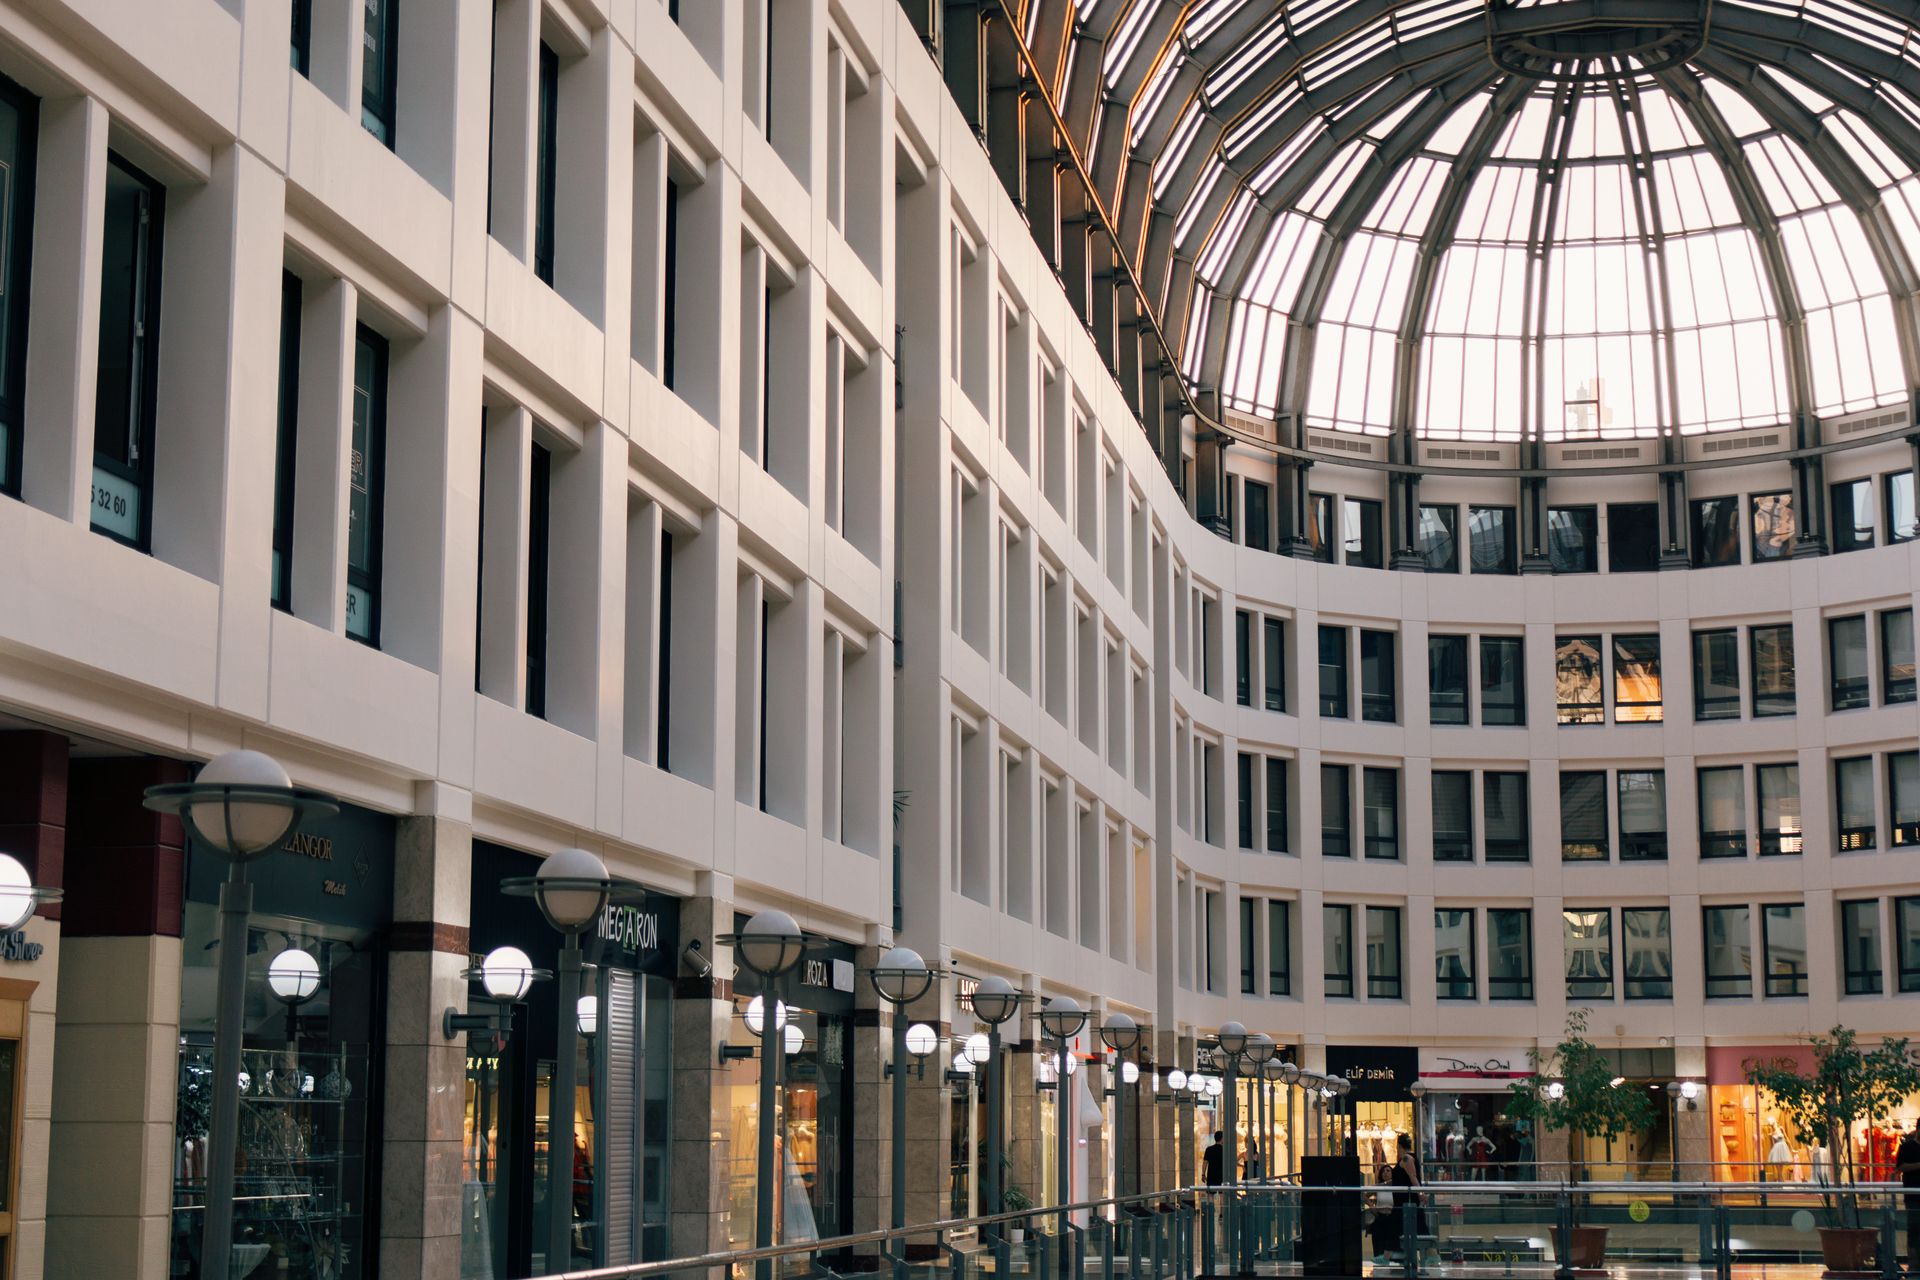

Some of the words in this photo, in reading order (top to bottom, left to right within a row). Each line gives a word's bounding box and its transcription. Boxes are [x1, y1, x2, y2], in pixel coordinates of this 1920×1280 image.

[98, 488, 111, 510] 32
[113, 495, 127, 518] 60
[281, 832, 333, 861] LANGOR
[598, 904, 658, 950] MEGARON
[9, 930, 44, 961] Silver
